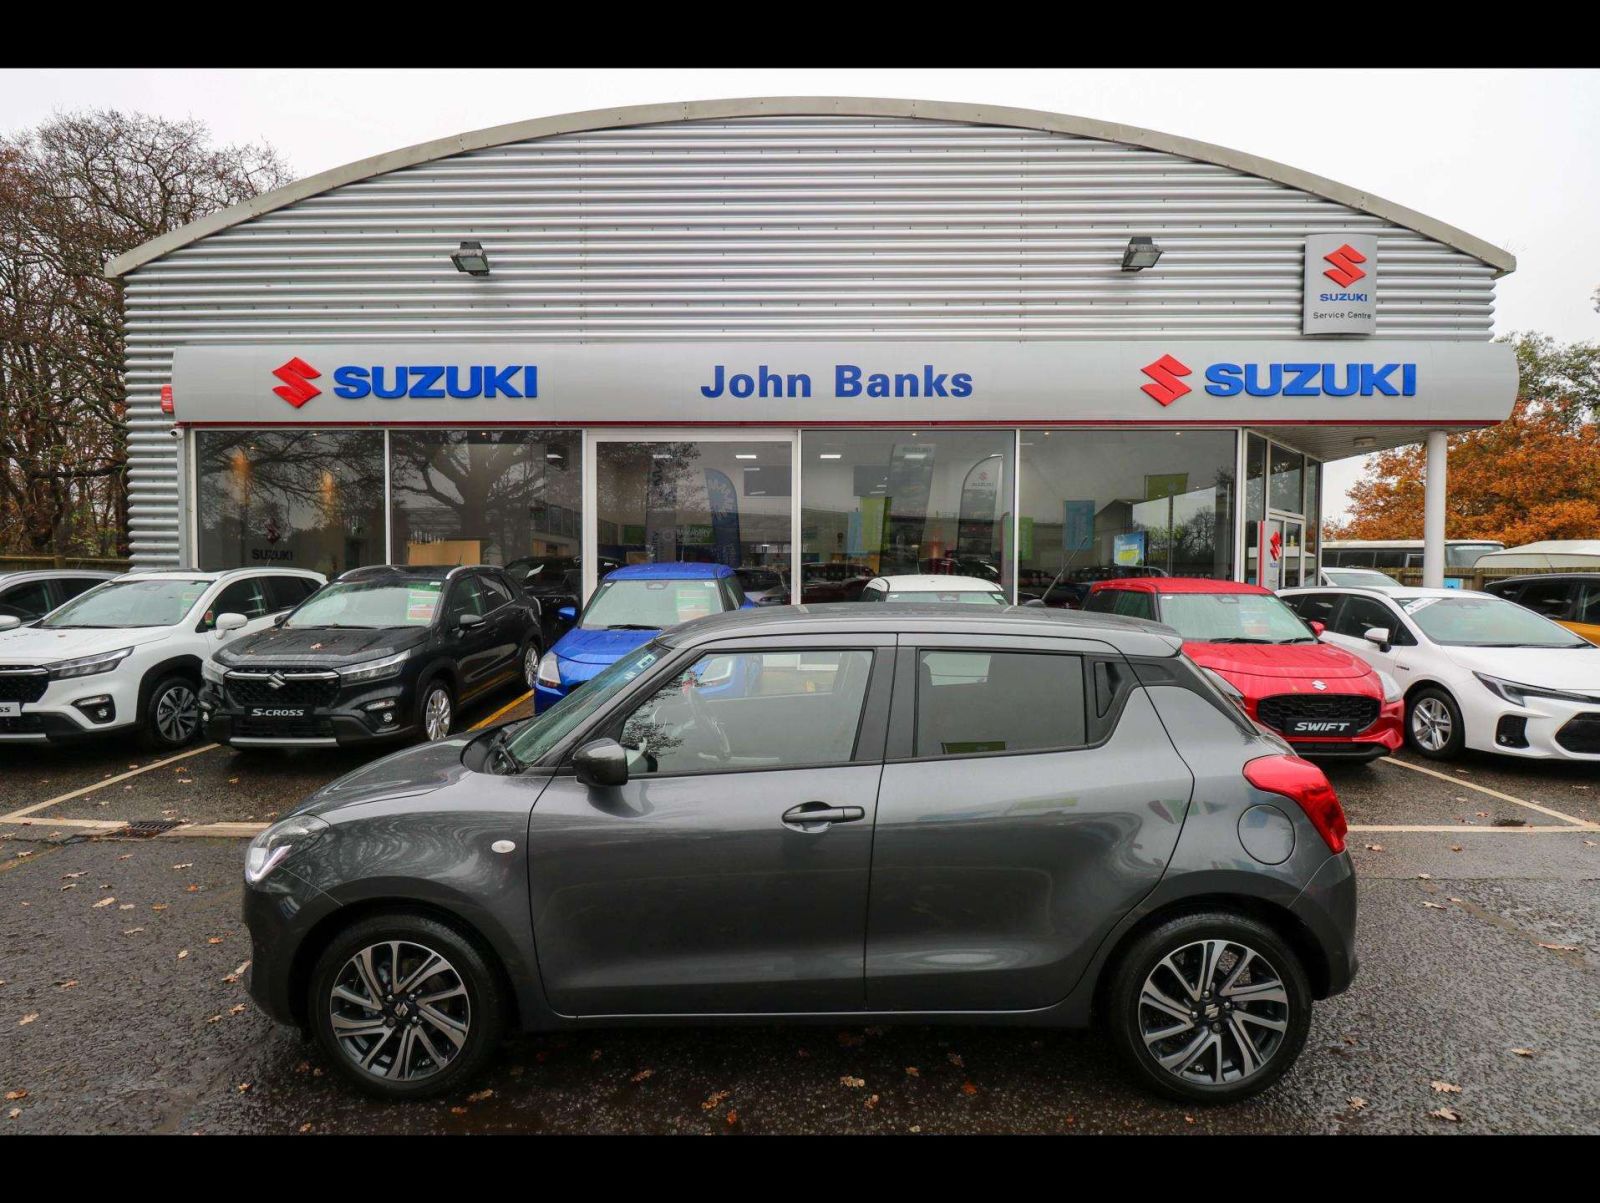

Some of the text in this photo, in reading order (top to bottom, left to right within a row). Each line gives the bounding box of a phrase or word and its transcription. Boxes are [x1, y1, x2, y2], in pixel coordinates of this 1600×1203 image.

[1313, 311, 1372, 319] Service Centre
[333, 366, 537, 398] SUZUKI
[700, 365, 973, 398] John Banks
[1205, 363, 1416, 396] SUZUKI
[1294, 722, 1350, 731] SWIFT
